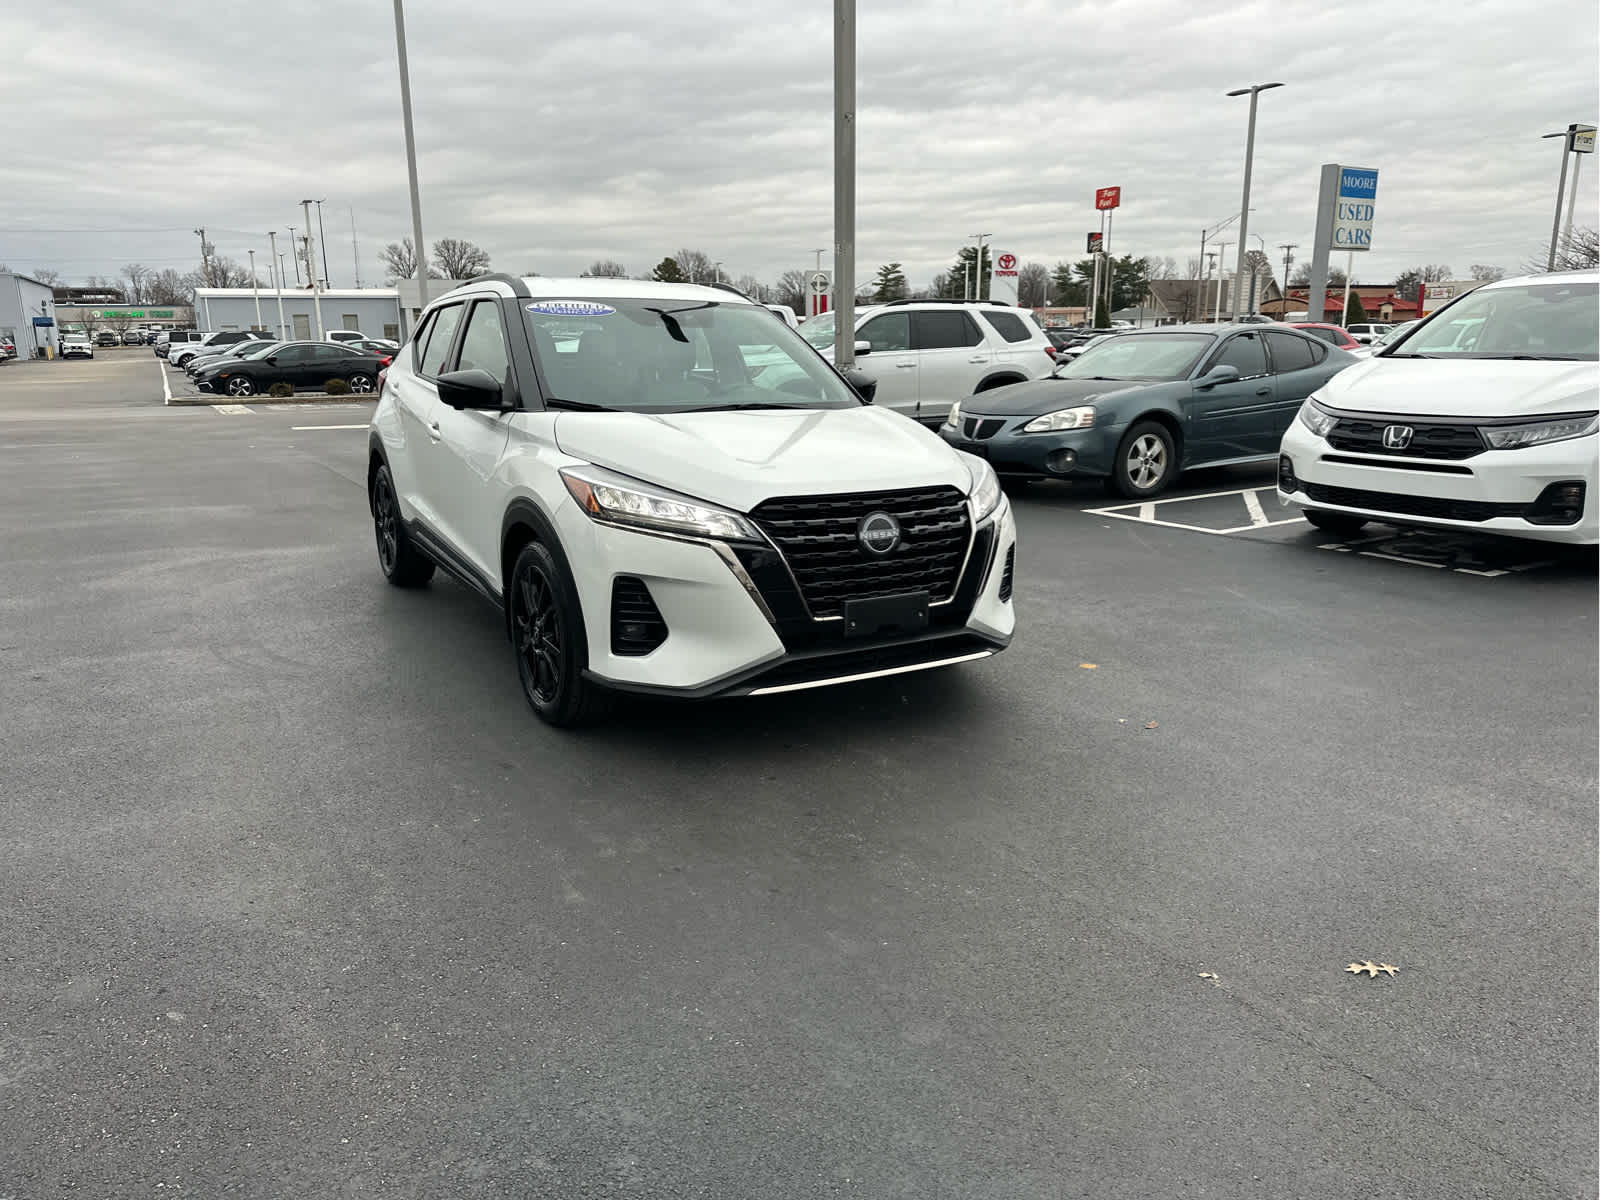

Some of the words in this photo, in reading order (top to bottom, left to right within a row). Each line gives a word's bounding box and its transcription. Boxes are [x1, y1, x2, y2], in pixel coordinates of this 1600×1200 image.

[1343, 175, 1376, 190] MOORE
[1338, 203, 1374, 221] USED
[1335, 226, 1372, 245] CARS
[860, 528, 900, 541] NISSAN
